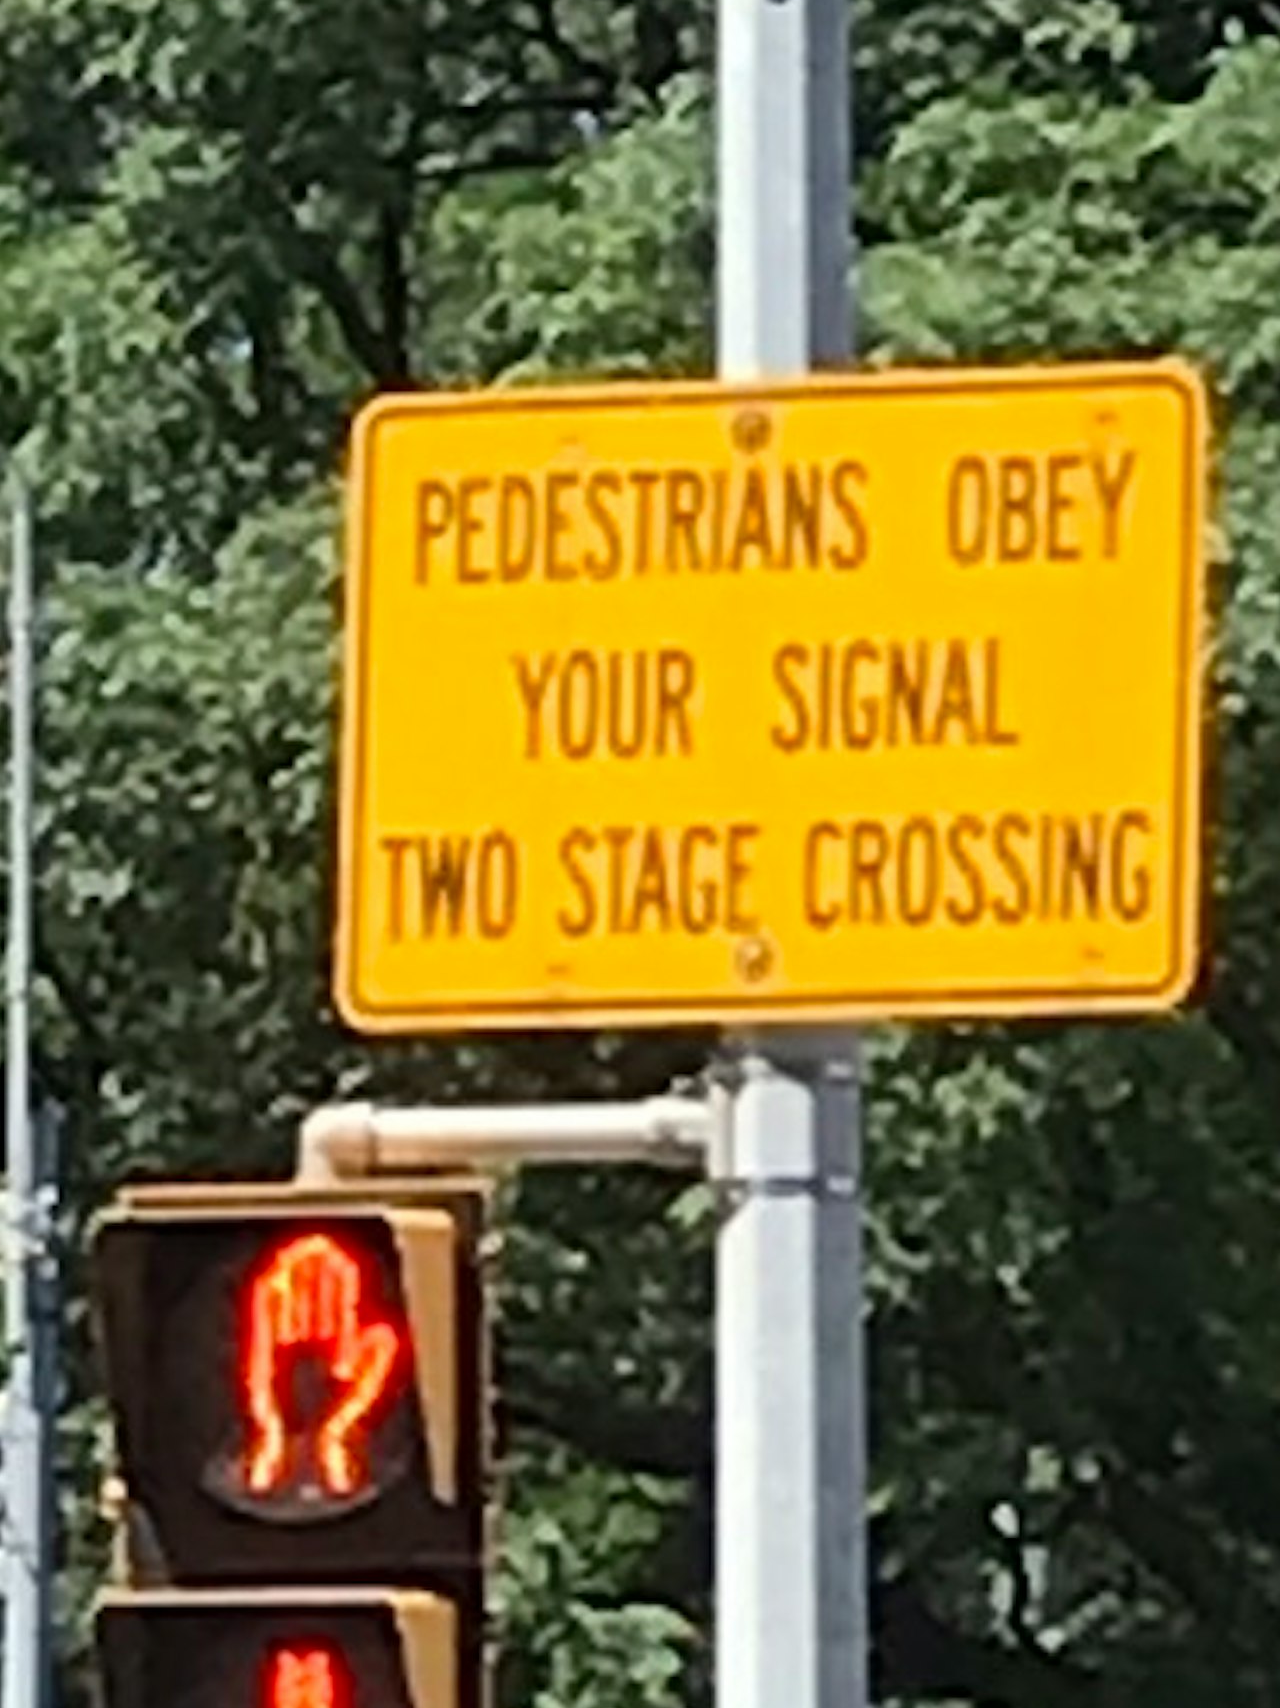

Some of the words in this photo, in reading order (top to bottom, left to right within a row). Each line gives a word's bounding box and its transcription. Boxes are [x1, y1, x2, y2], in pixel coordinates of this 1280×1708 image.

[413, 458, 869, 585] PEDESTRIANS
[946, 450, 1136, 567] OBEY
[511, 649, 696, 760] YOUR
[770, 637, 1019, 754] SIGNAL
[380, 827, 518, 944] TWO
[555, 824, 761, 938] STAGE
[803, 810, 1152, 930] CROSSING
